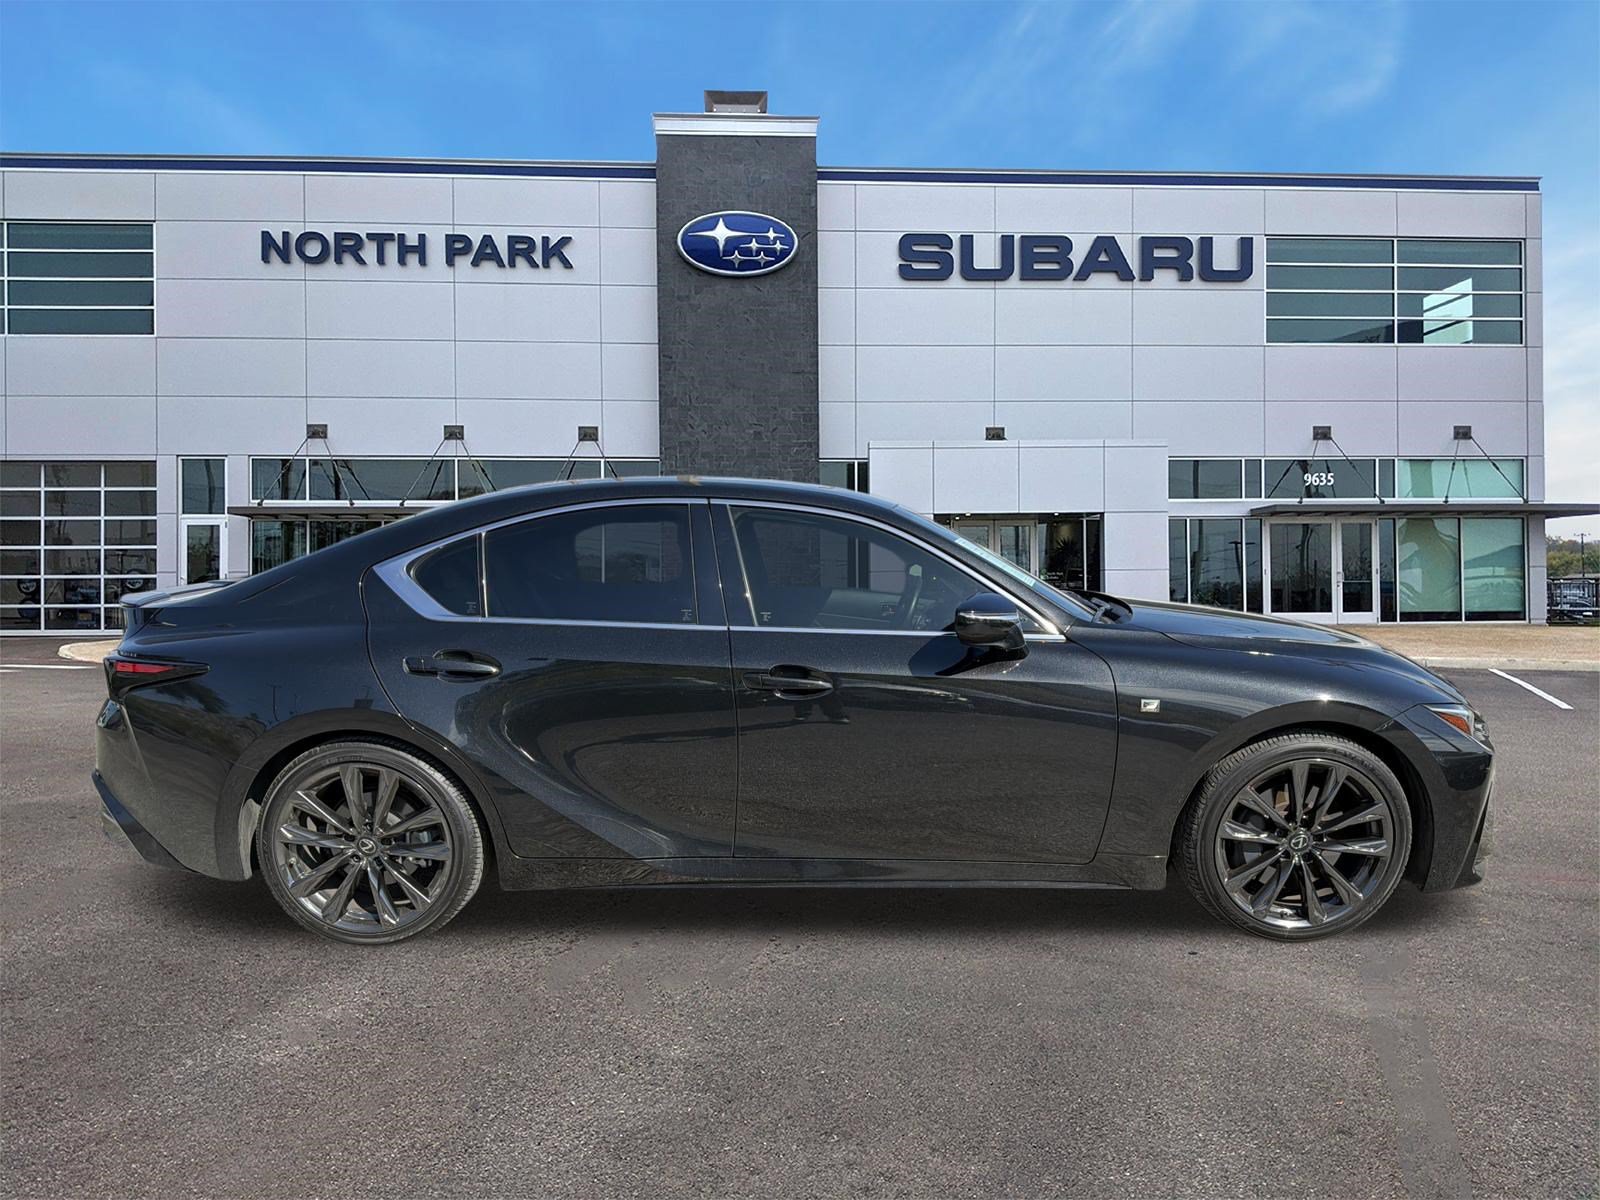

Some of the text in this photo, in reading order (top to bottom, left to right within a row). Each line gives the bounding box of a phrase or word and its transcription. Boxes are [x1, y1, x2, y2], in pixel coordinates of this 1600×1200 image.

[261, 230, 574, 269] NORTH PARK
[898, 233, 1254, 282] SUBARU
[1304, 472, 1335, 486] 9635
